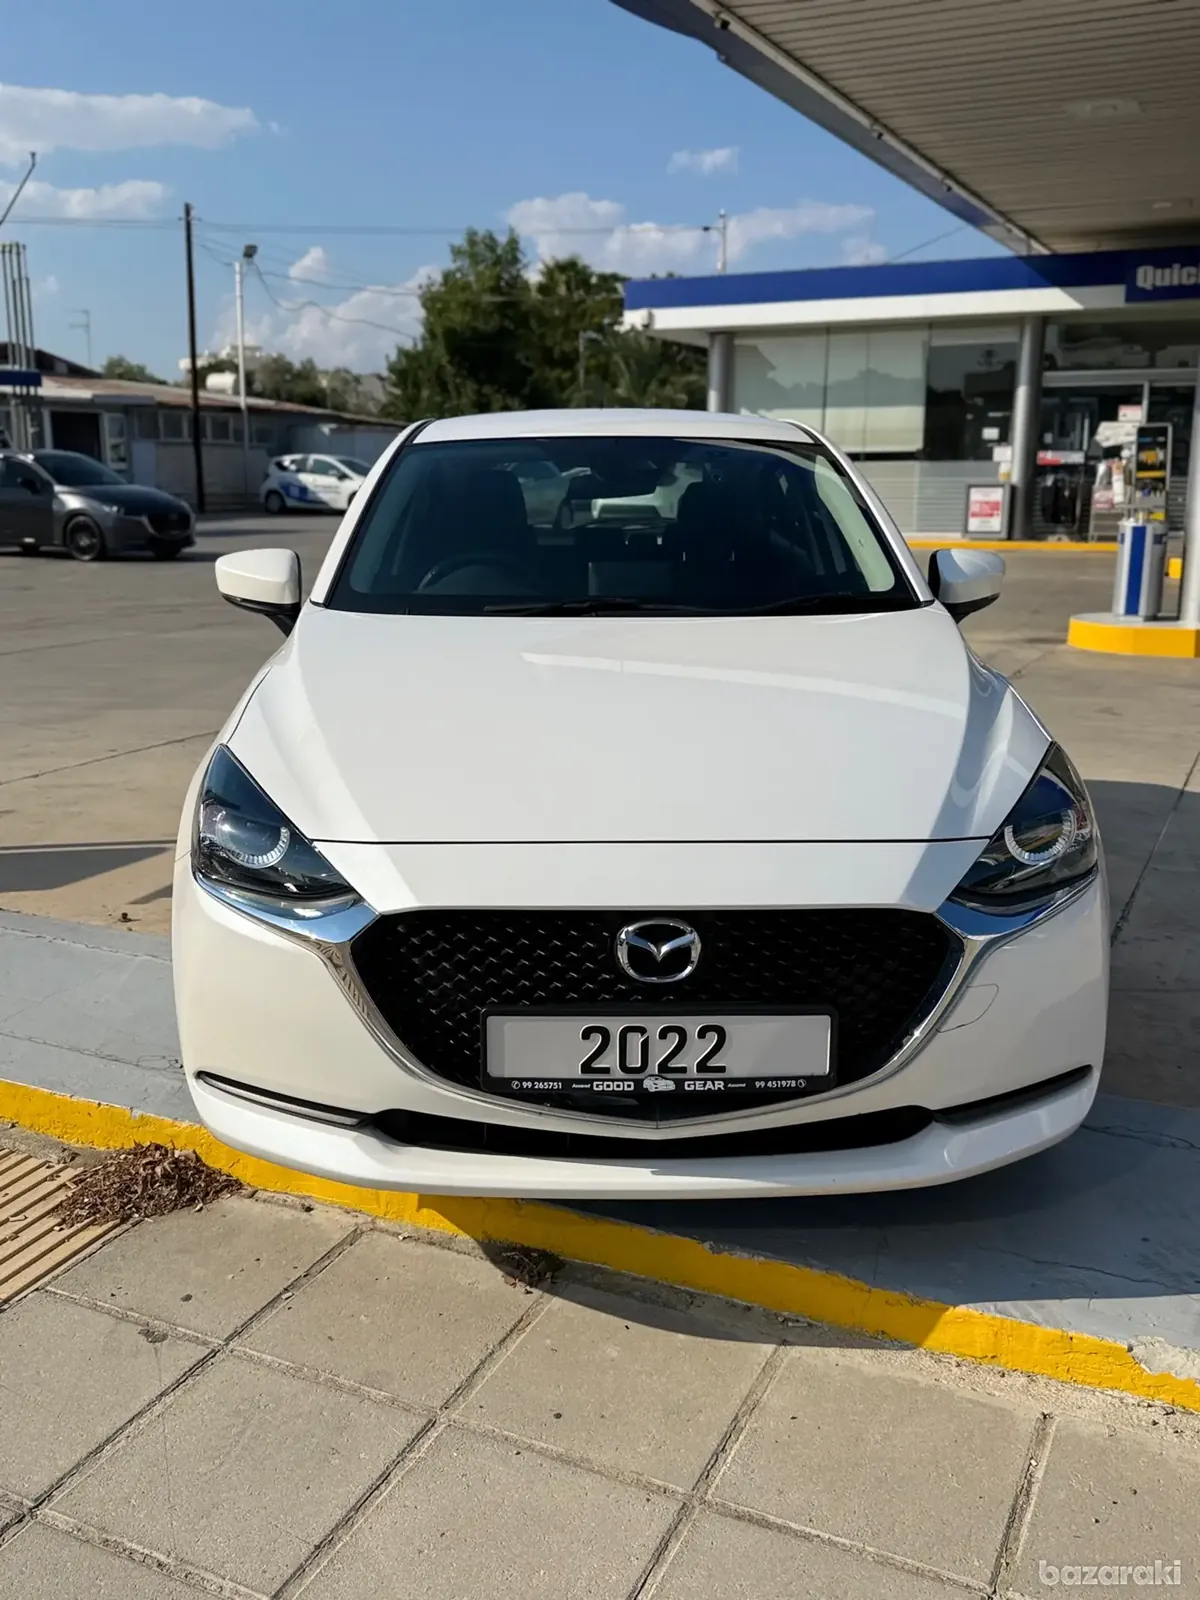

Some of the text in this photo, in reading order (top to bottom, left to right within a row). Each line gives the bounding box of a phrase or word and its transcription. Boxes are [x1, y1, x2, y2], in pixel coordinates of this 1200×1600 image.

[1136, 262, 1200, 291] Quic
[579, 1023, 727, 1075] 2022
[522, 1081, 532, 1089] 99
[534, 1081, 562, 1090] 265751
[593, 1081, 635, 1091] GOOD
[684, 1081, 725, 1091] GEAR
[755, 1081, 765, 1089] 99
[767, 1080, 796, 1089] 451978
